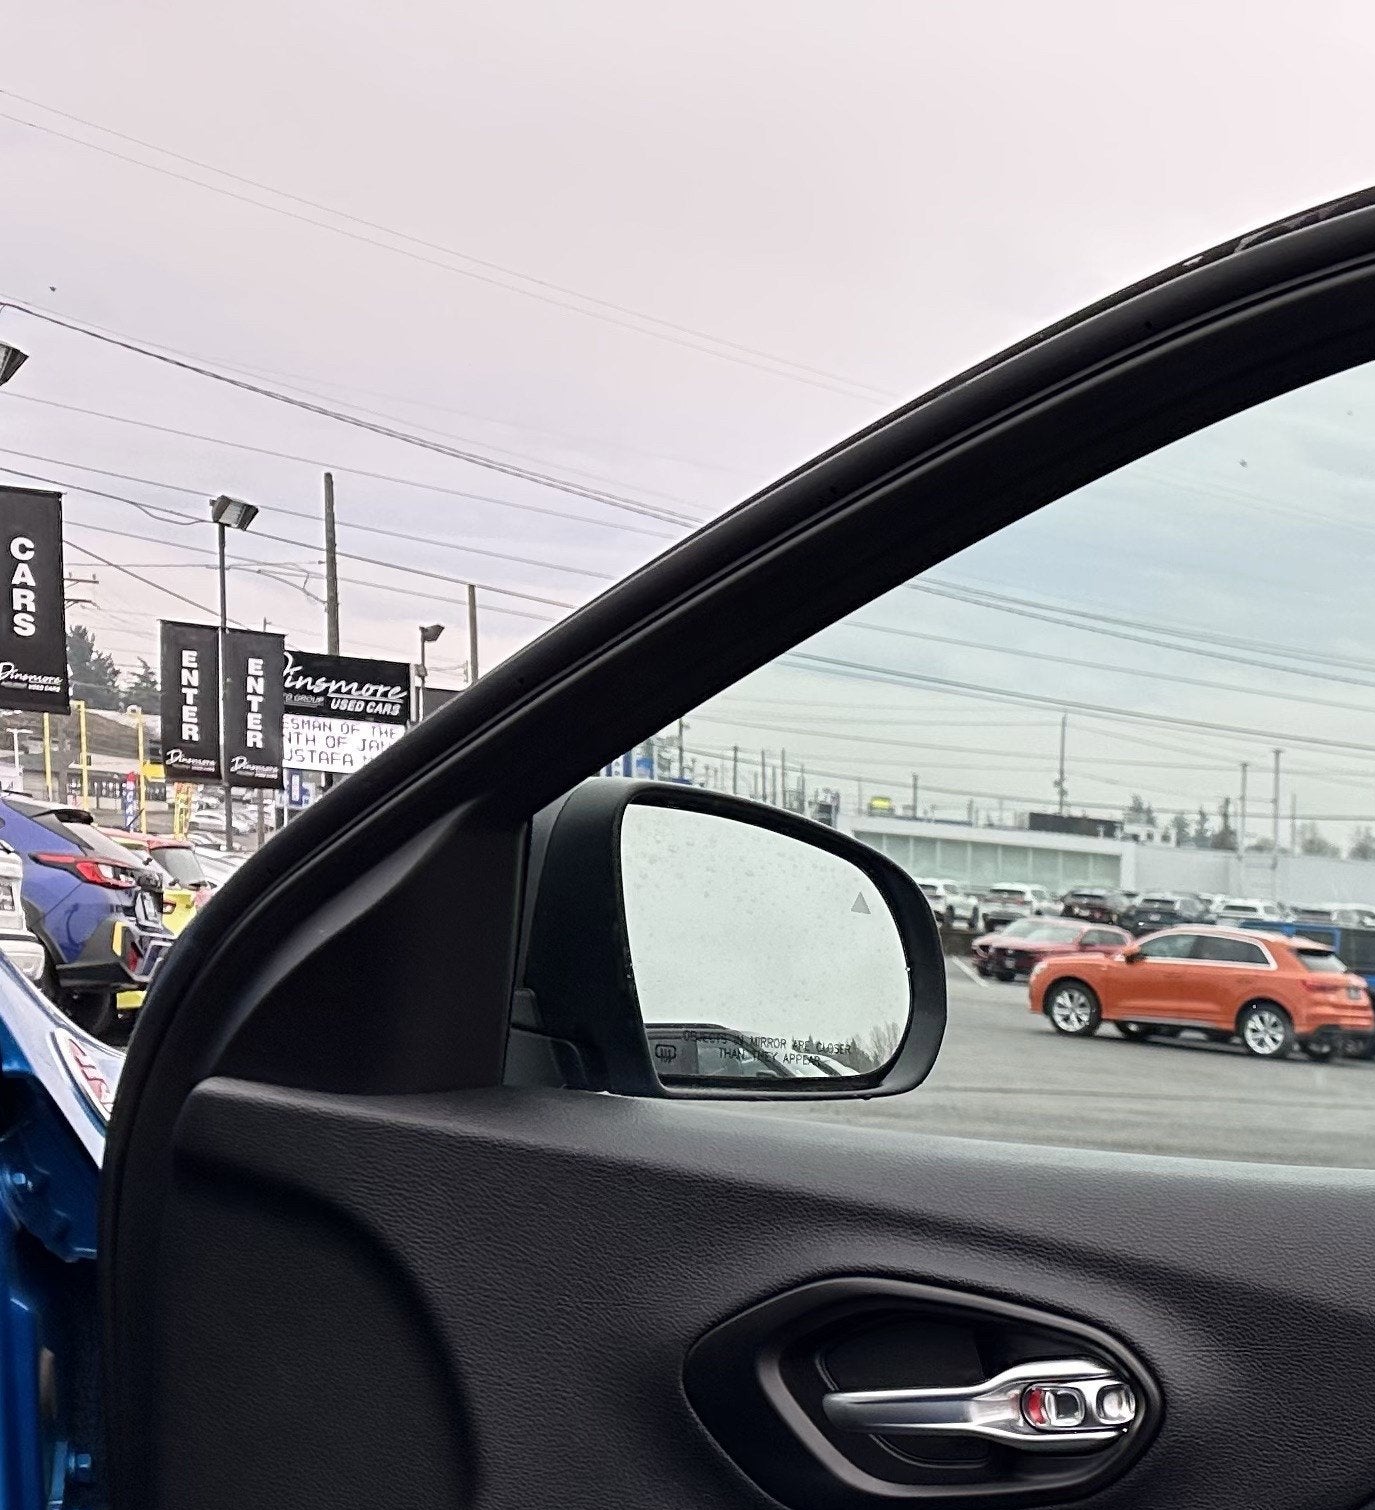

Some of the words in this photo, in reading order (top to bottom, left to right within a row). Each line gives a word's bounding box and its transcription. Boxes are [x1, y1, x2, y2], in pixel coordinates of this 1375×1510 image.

[10, 536, 36, 637] CARS
[283, 651, 408, 700] insmore
[181, 649, 199, 741] ENTER
[246, 657, 265, 748] ENTER
[330, 698, 365, 712] USED
[366, 700, 401, 716] CARS
[341, 721, 360, 735] OF
[283, 748, 354, 767] USTAFA
[750, 1036, 787, 1049] MIRROR
[792, 1039, 810, 1052] ARE
[816, 1041, 852, 1055] CLOSER
[783, 1053, 821, 1067] APPEAR
